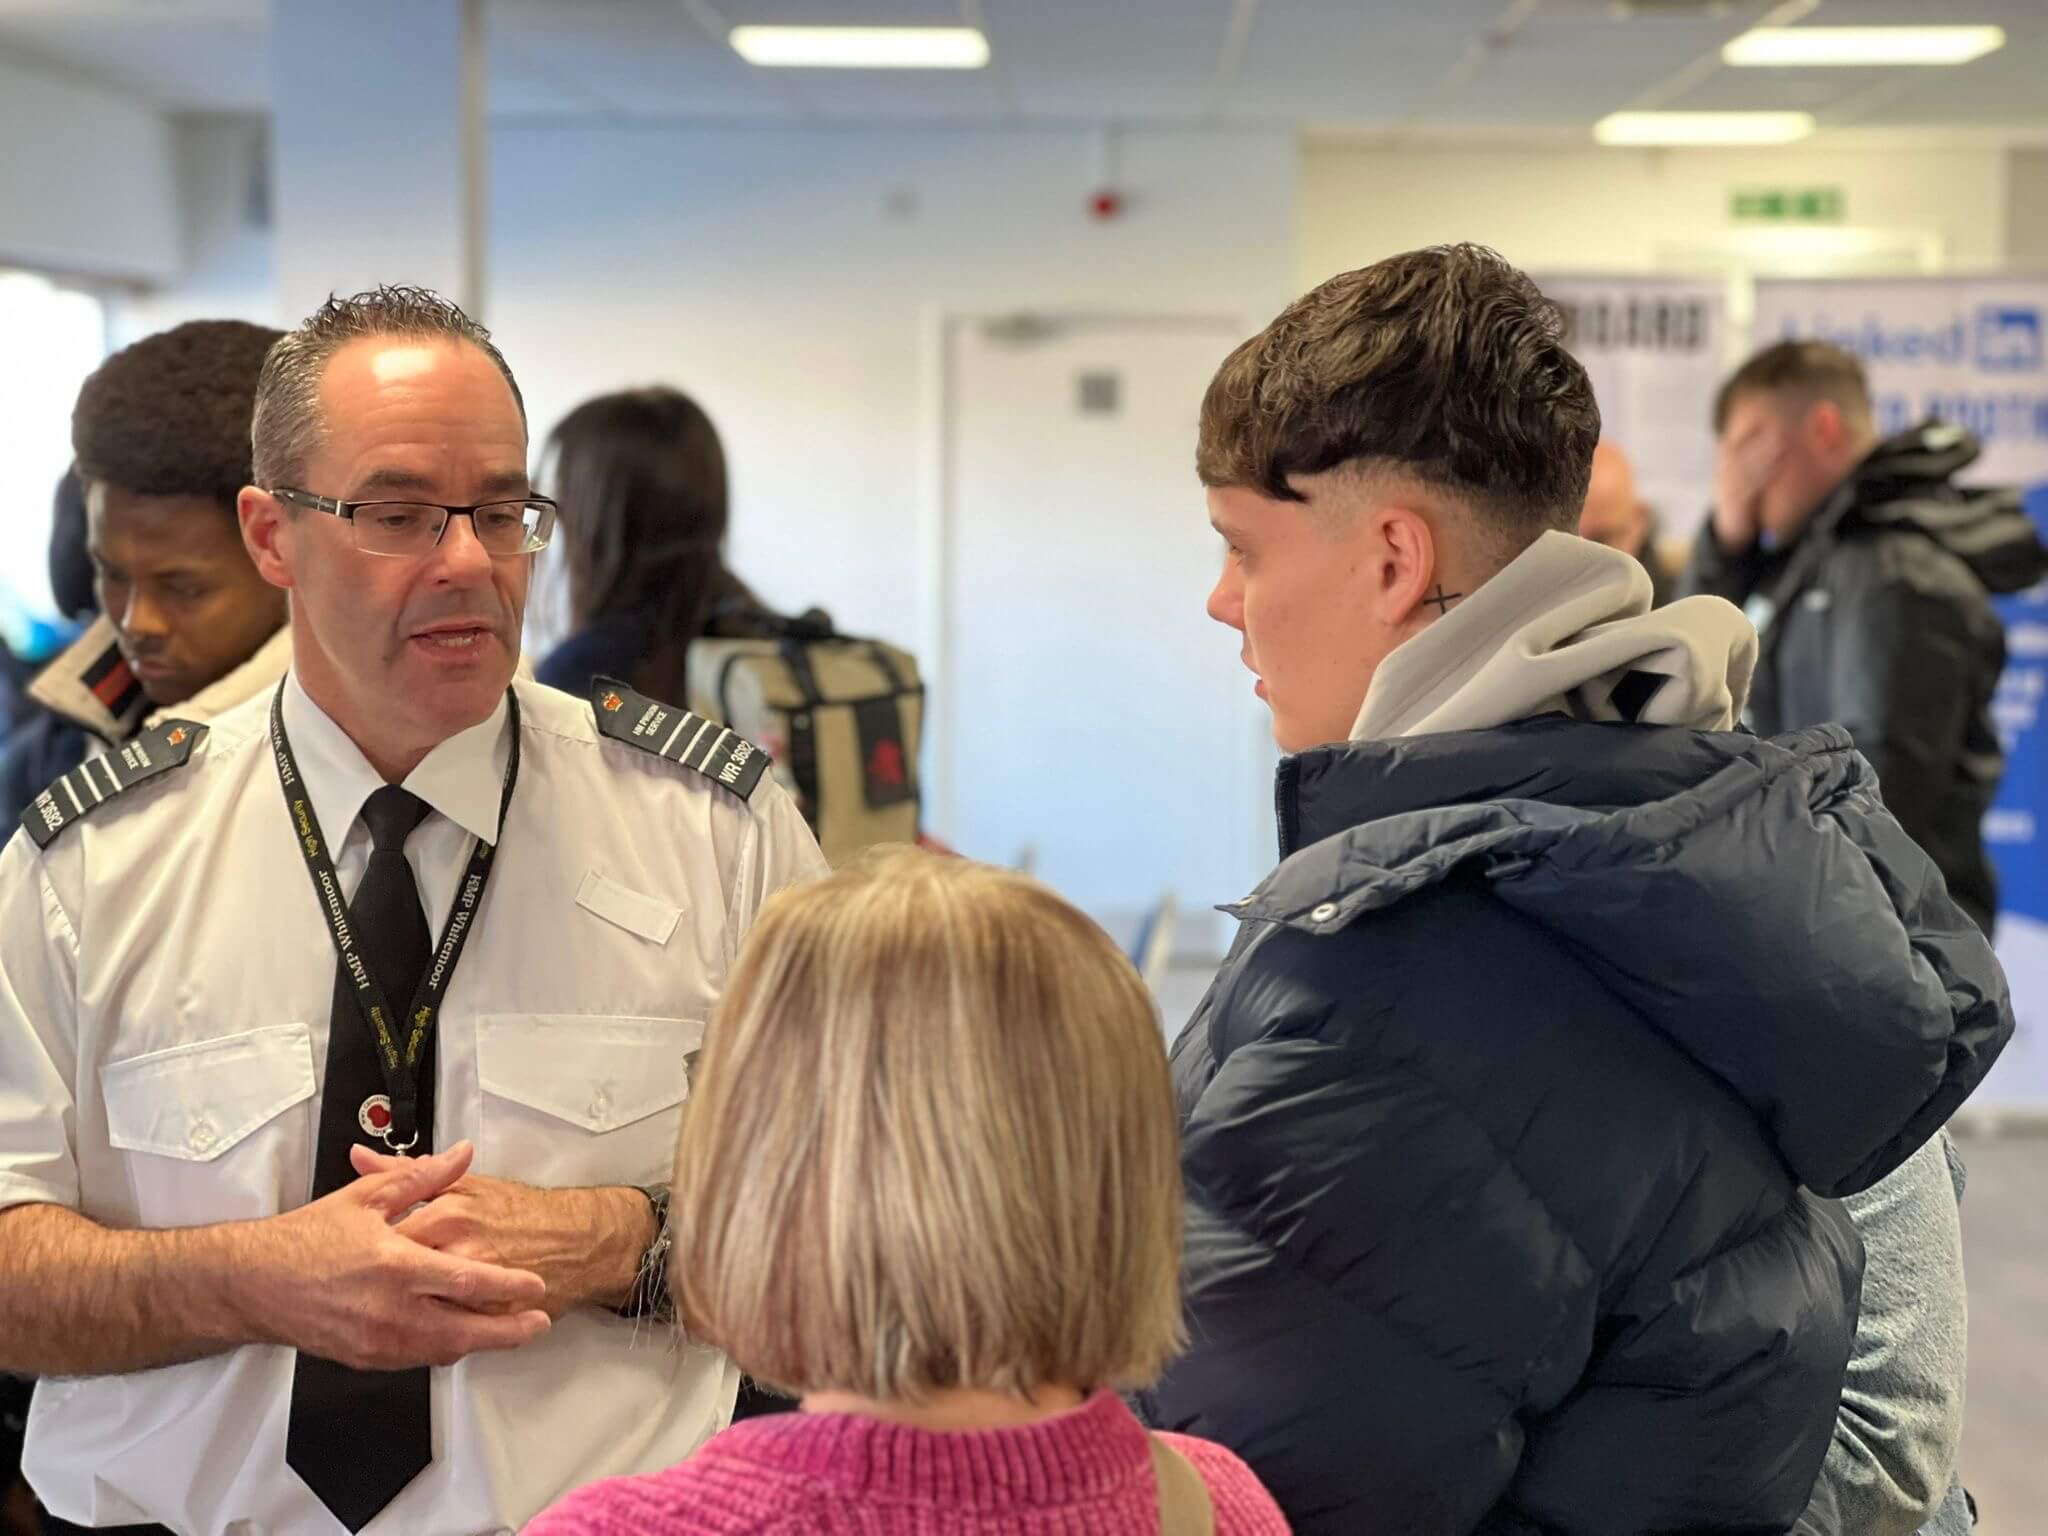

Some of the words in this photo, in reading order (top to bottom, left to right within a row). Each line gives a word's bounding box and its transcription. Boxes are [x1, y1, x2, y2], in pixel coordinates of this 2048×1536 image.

[277, 752, 295, 786] HMP
[718, 762, 742, 784] WR
[731, 740, 755, 767] 3682
[40, 800, 65, 832] 3682
[304, 837, 318, 858] High
[462, 873, 482, 909] HMP
[318, 870, 353, 954] Whitemoor
[428, 910, 469, 990] Whitemoor
[347, 953, 370, 990] HMP
